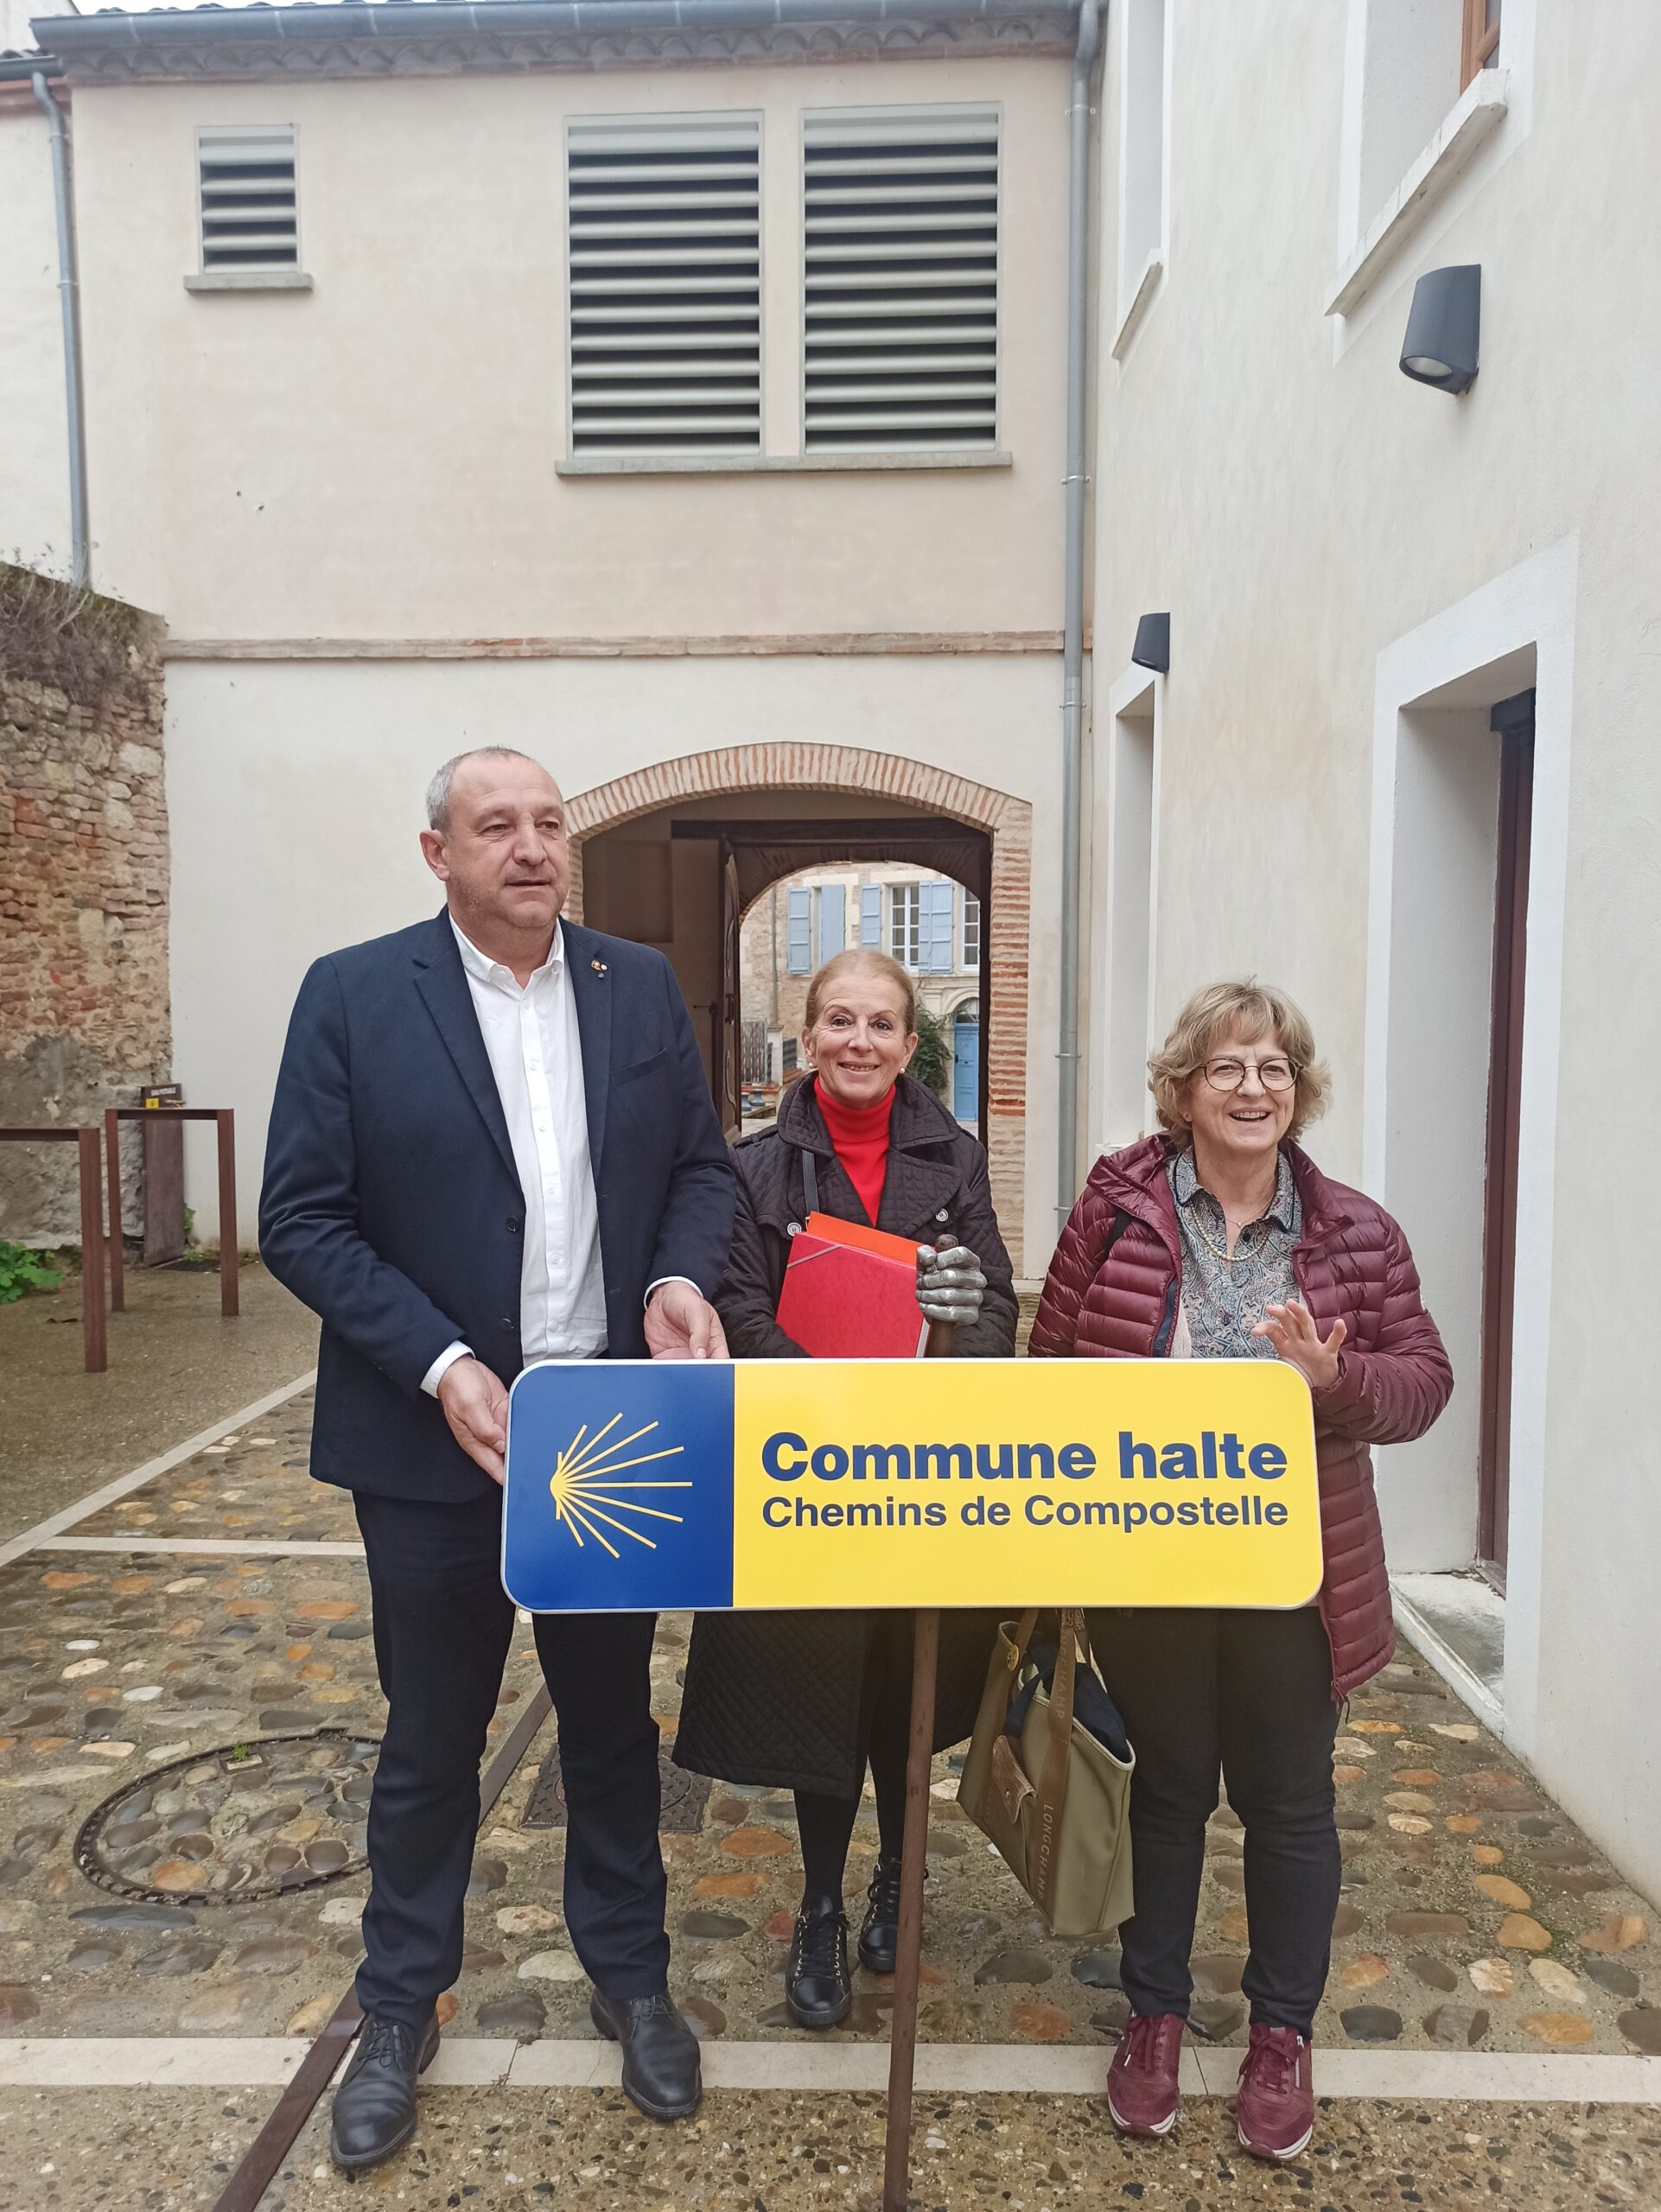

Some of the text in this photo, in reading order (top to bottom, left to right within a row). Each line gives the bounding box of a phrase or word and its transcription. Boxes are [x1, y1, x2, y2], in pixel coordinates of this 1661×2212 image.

[761, 1431, 1288, 1482] Commune halte
[762, 1494, 1289, 1534] Chemins de Compostelle
[1037, 1803, 1054, 1900] LONGCHAMP
